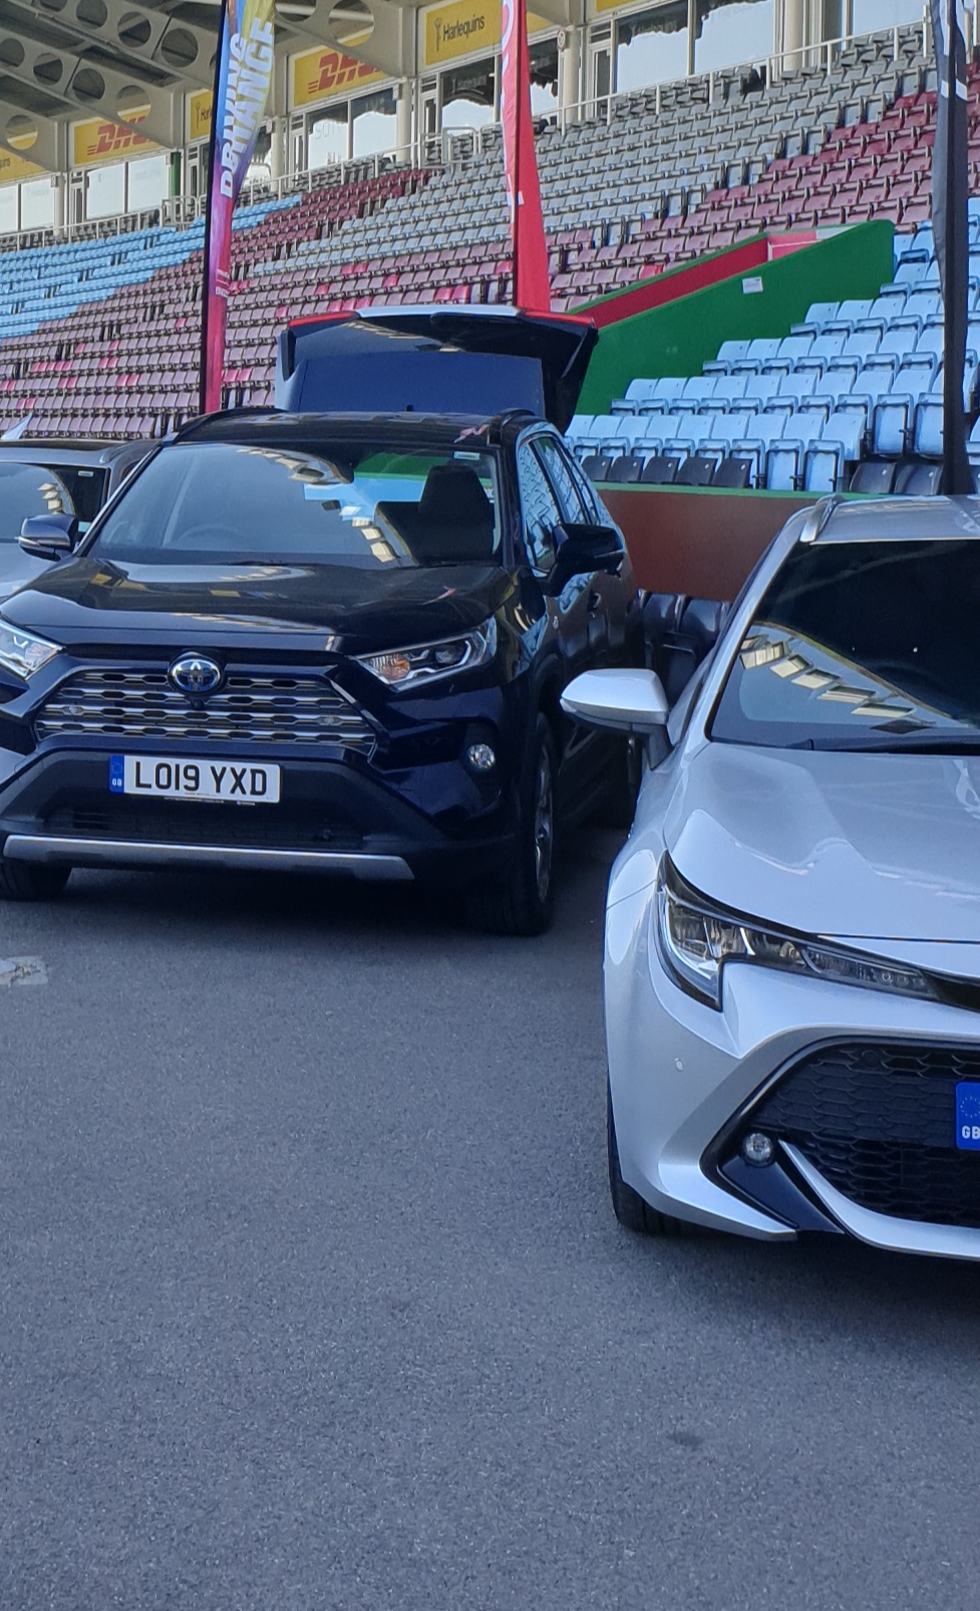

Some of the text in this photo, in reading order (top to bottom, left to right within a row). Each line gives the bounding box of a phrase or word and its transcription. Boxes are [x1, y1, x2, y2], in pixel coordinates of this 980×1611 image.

[443, 15, 485, 41] Harlequins
[134, 761, 267, 796] LO19 YXD
[962, 1125, 980, 1139] GB
